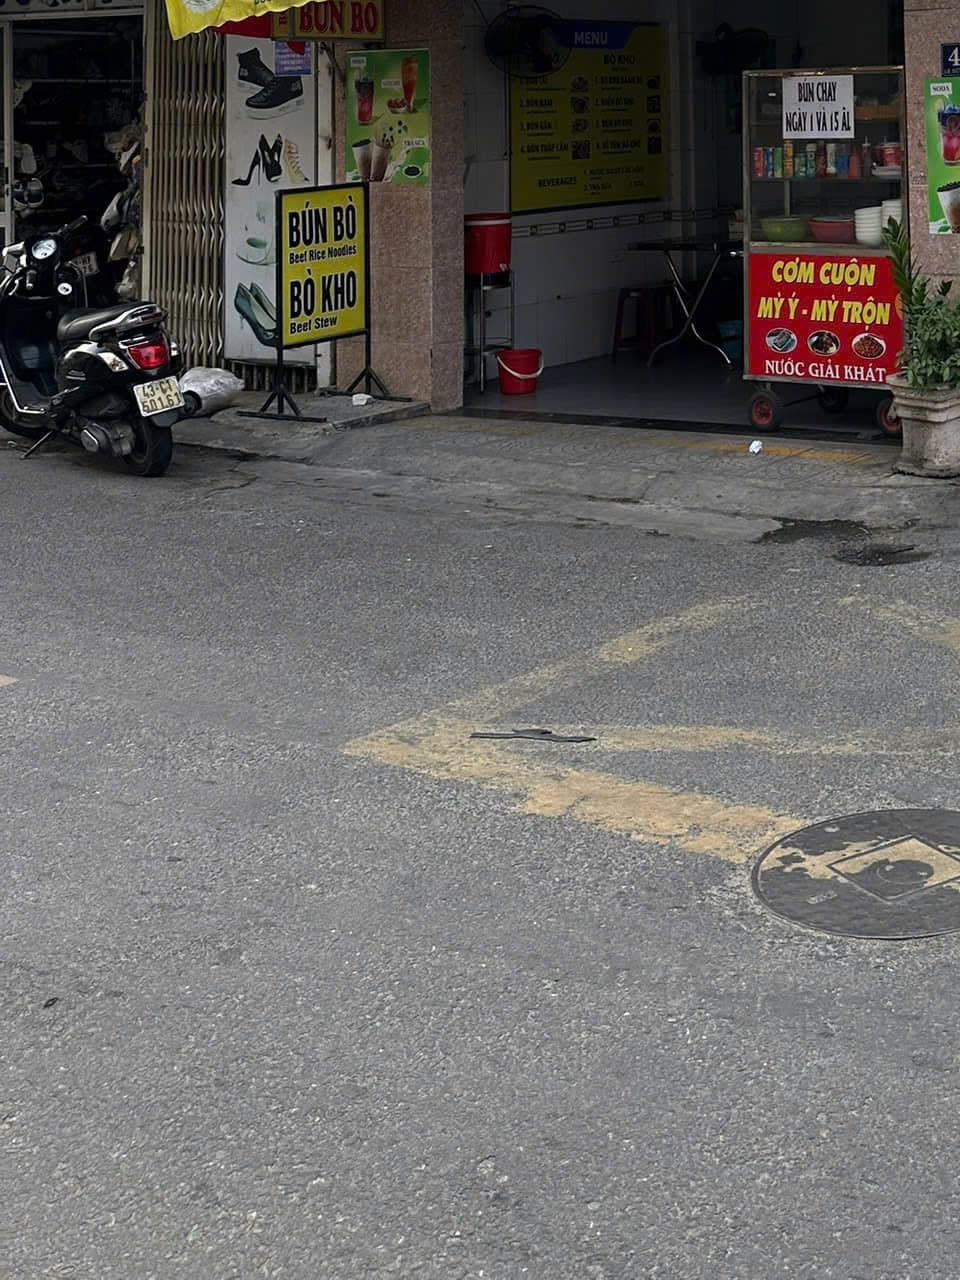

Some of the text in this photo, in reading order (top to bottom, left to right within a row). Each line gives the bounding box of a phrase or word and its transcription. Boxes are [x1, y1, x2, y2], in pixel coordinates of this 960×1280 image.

[573, 31, 609, 46] MENU
[797, 78, 837, 102] BÚN CHAY
[785, 107, 808, 132] NGÀY
[810, 112, 814, 132] 1
[816, 106, 827, 132] VÀ
[830, 112, 839, 131] 15
[288, 195, 357, 249] BÚN BÒ
[289, 244, 357, 265] Beef Rice Noodles
[772, 257, 876, 293] CƠM CUỘN
[290, 268, 357, 320] BÒ KHO
[757, 291, 784, 319] MỲ
[788, 291, 800, 320] Ý
[810, 294, 839, 322] MỲ
[842, 296, 891, 332] TRỘN
[289, 315, 338, 335] Beef Stew
[765, 357, 887, 382] NƯỚC GIẢI KHÁT
